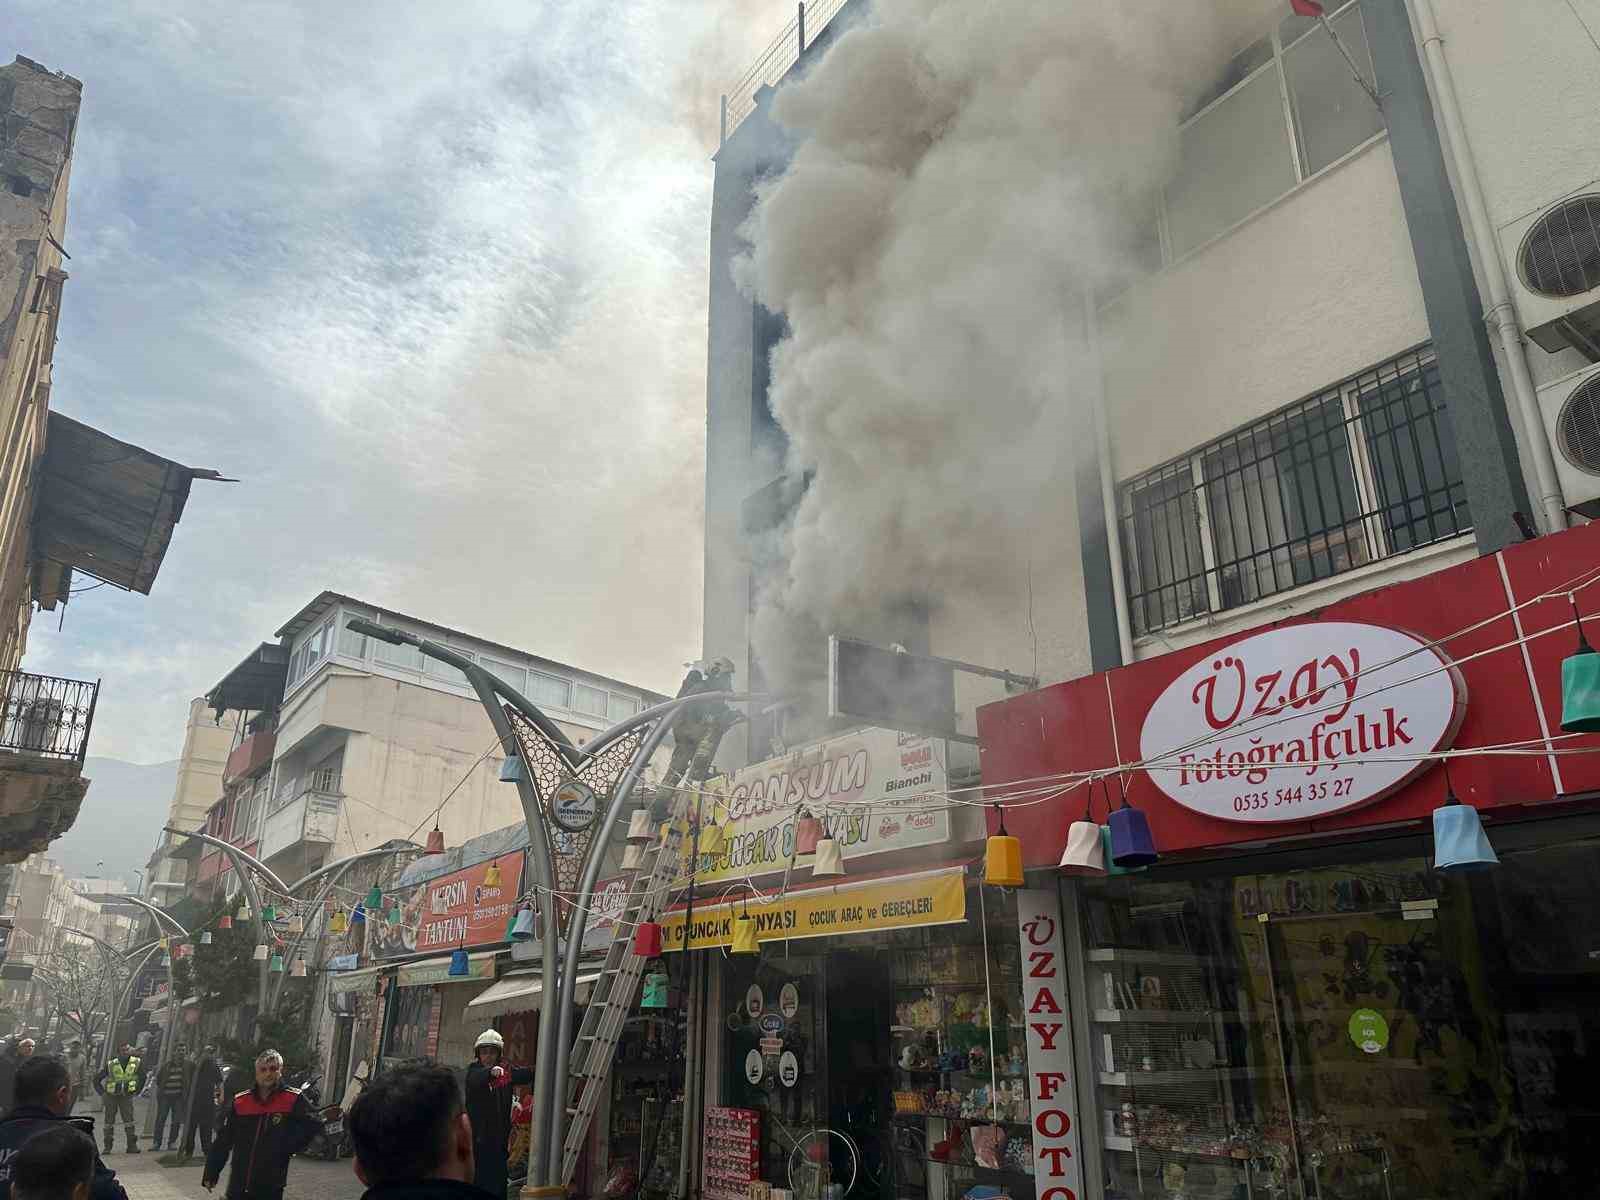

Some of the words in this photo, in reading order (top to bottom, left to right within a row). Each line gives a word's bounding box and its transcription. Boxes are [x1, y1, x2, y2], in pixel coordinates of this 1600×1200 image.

[1192, 648, 1360, 730] Üzay
[1179, 707, 1414, 786] Fotoğrafçılık
[885, 771, 932, 792] Bianchi
[1233, 792, 1268, 812] 0535
[1274, 785, 1303, 806] 544
[1308, 782, 1328, 801] 35
[1333, 777, 1354, 796] 27
[702, 826, 779, 872] UNCAK
[782, 808, 871, 858] DYASI
[750, 910, 797, 931] NYASI
[809, 909, 837, 928] ÇOCUK
[840, 906, 863, 924] ARAÇ
[866, 908, 878, 920] ve
[881, 896, 933, 918] GEREÇLERİ
[1021, 914, 1063, 1050] ÜZAY
